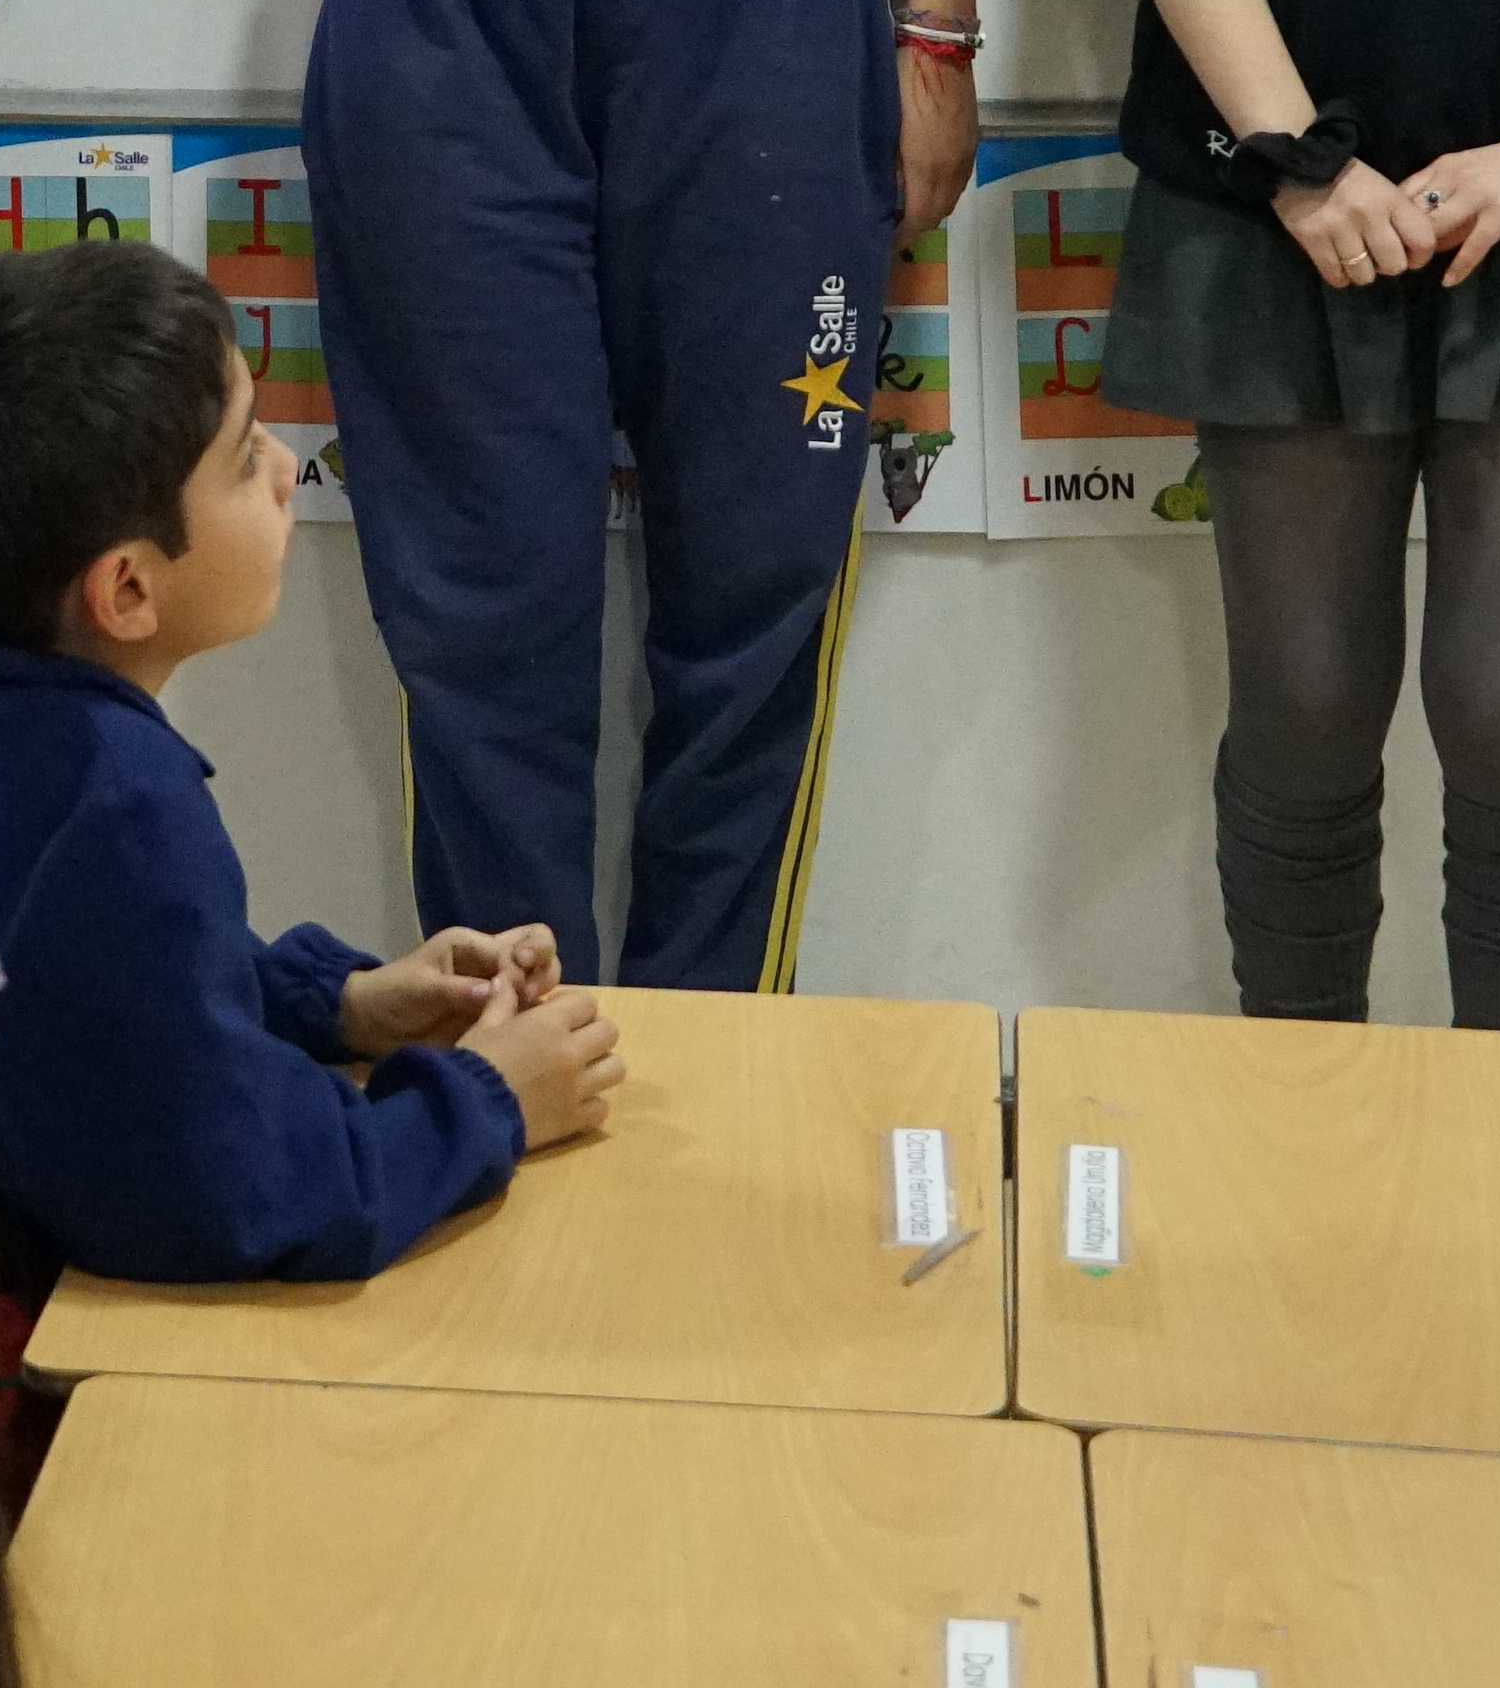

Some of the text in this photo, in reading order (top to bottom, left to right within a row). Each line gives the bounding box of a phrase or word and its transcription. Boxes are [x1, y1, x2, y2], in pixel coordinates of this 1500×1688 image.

[78, 150, 149, 166] La Salle
[236, 179, 282, 256] I
[1047, 189, 1103, 267] L
[843, 307, 858, 354] CHILE
[808, 274, 845, 451] La Salle
[1022, 465, 1135, 503] LIMÓN
